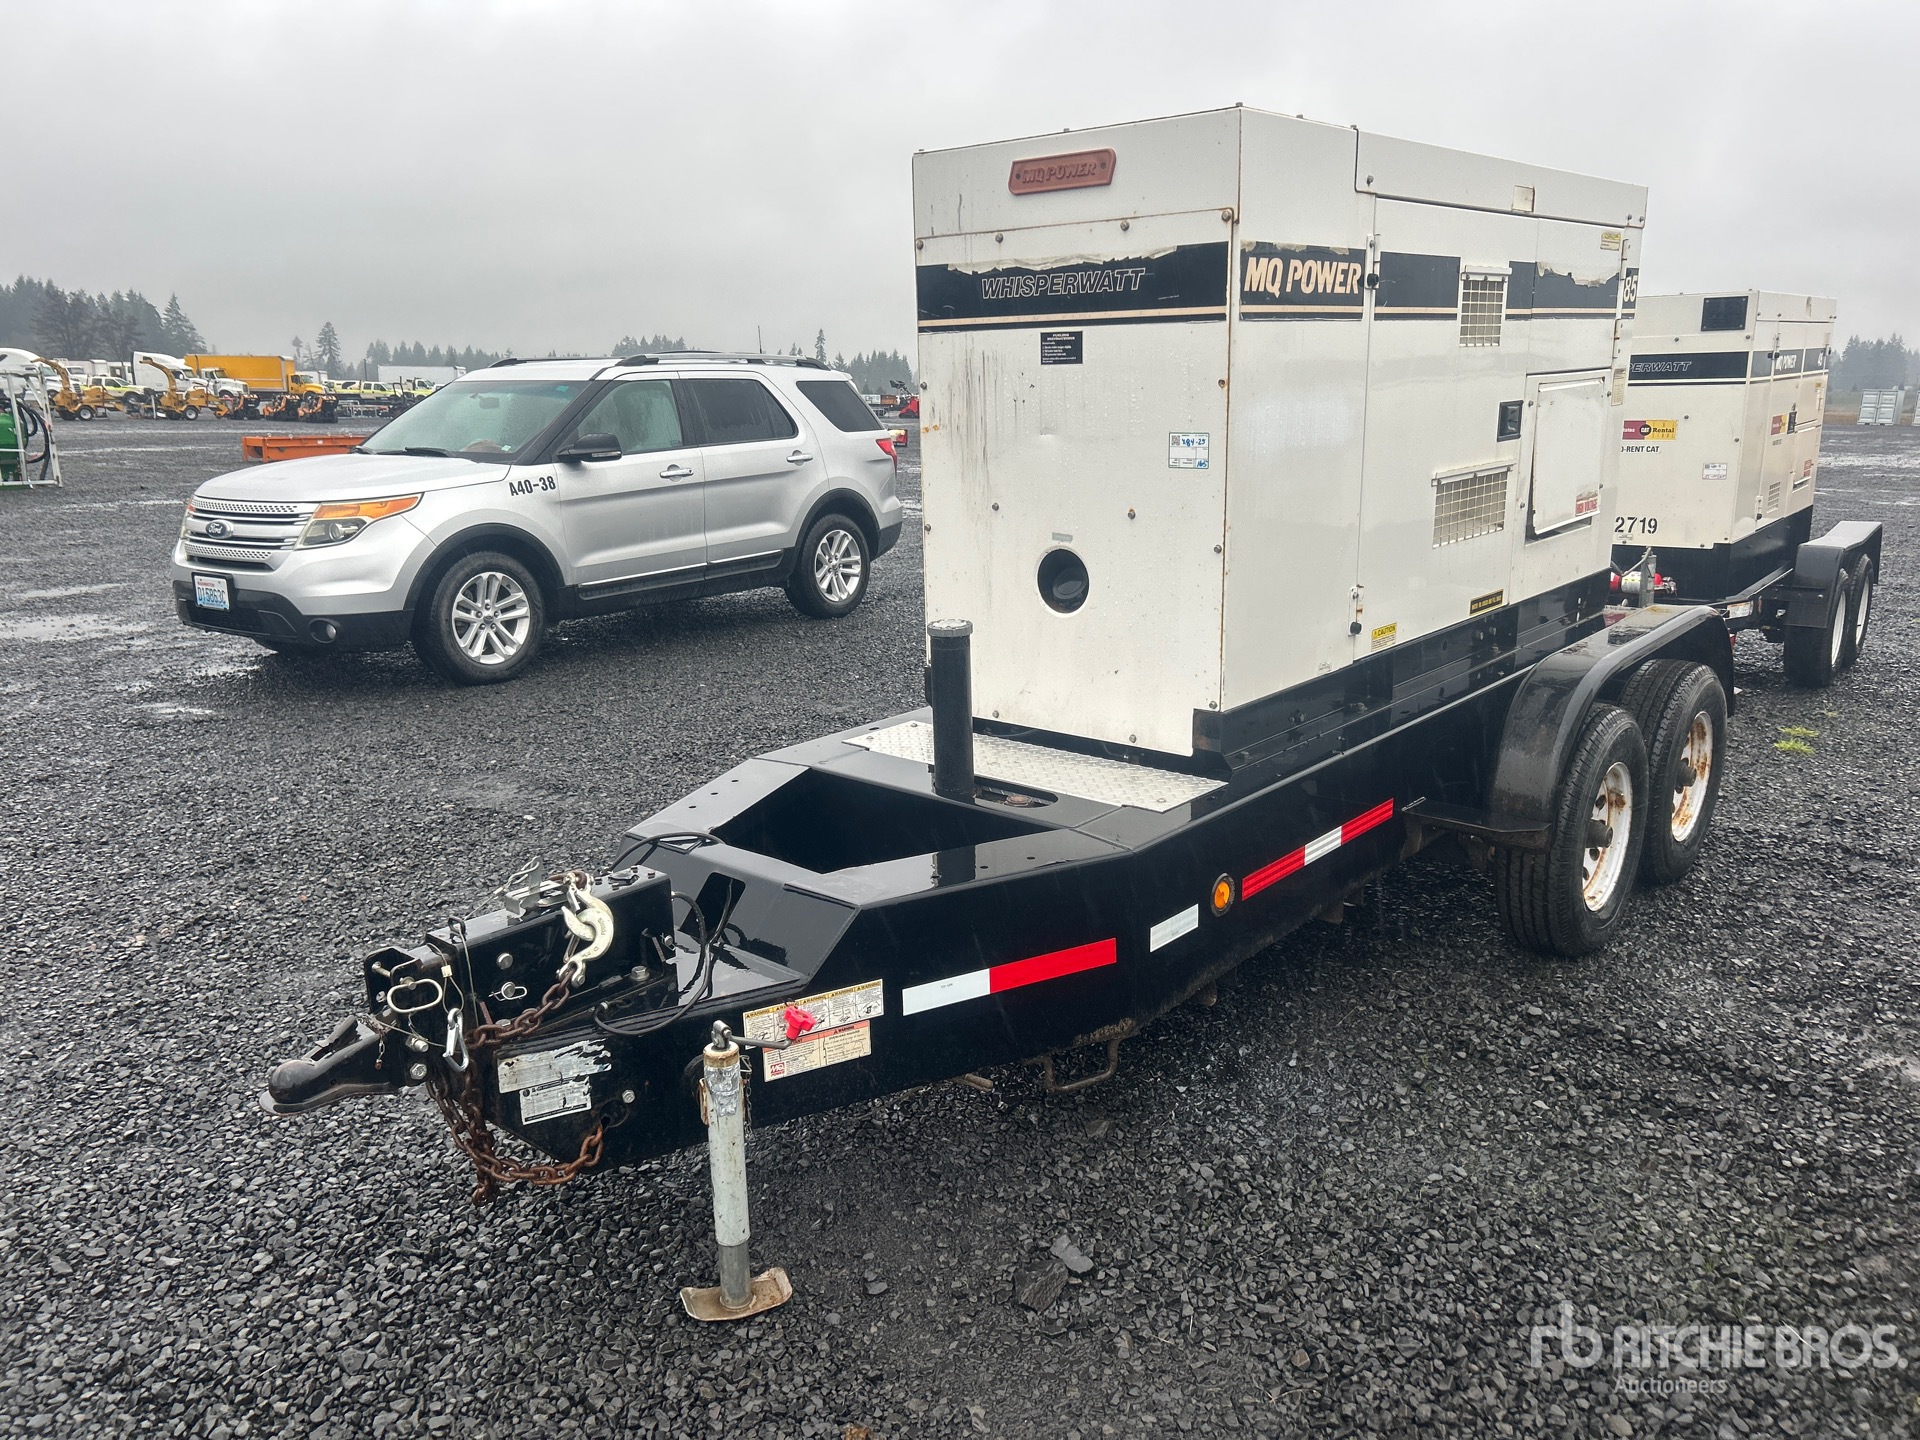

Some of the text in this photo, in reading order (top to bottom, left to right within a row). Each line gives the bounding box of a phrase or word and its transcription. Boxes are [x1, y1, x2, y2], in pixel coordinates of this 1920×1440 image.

[1022, 162, 1097, 184] MQ POWER
[981, 267, 1146, 300] WHISPERWATT
[1243, 256, 1362, 298] MQ POWER
[1623, 275, 1639, 302] 85
[509, 475, 557, 497] A40-38
[1614, 516, 1658, 534] 2719
[1378, 625, 1396, 636] CAUTION
